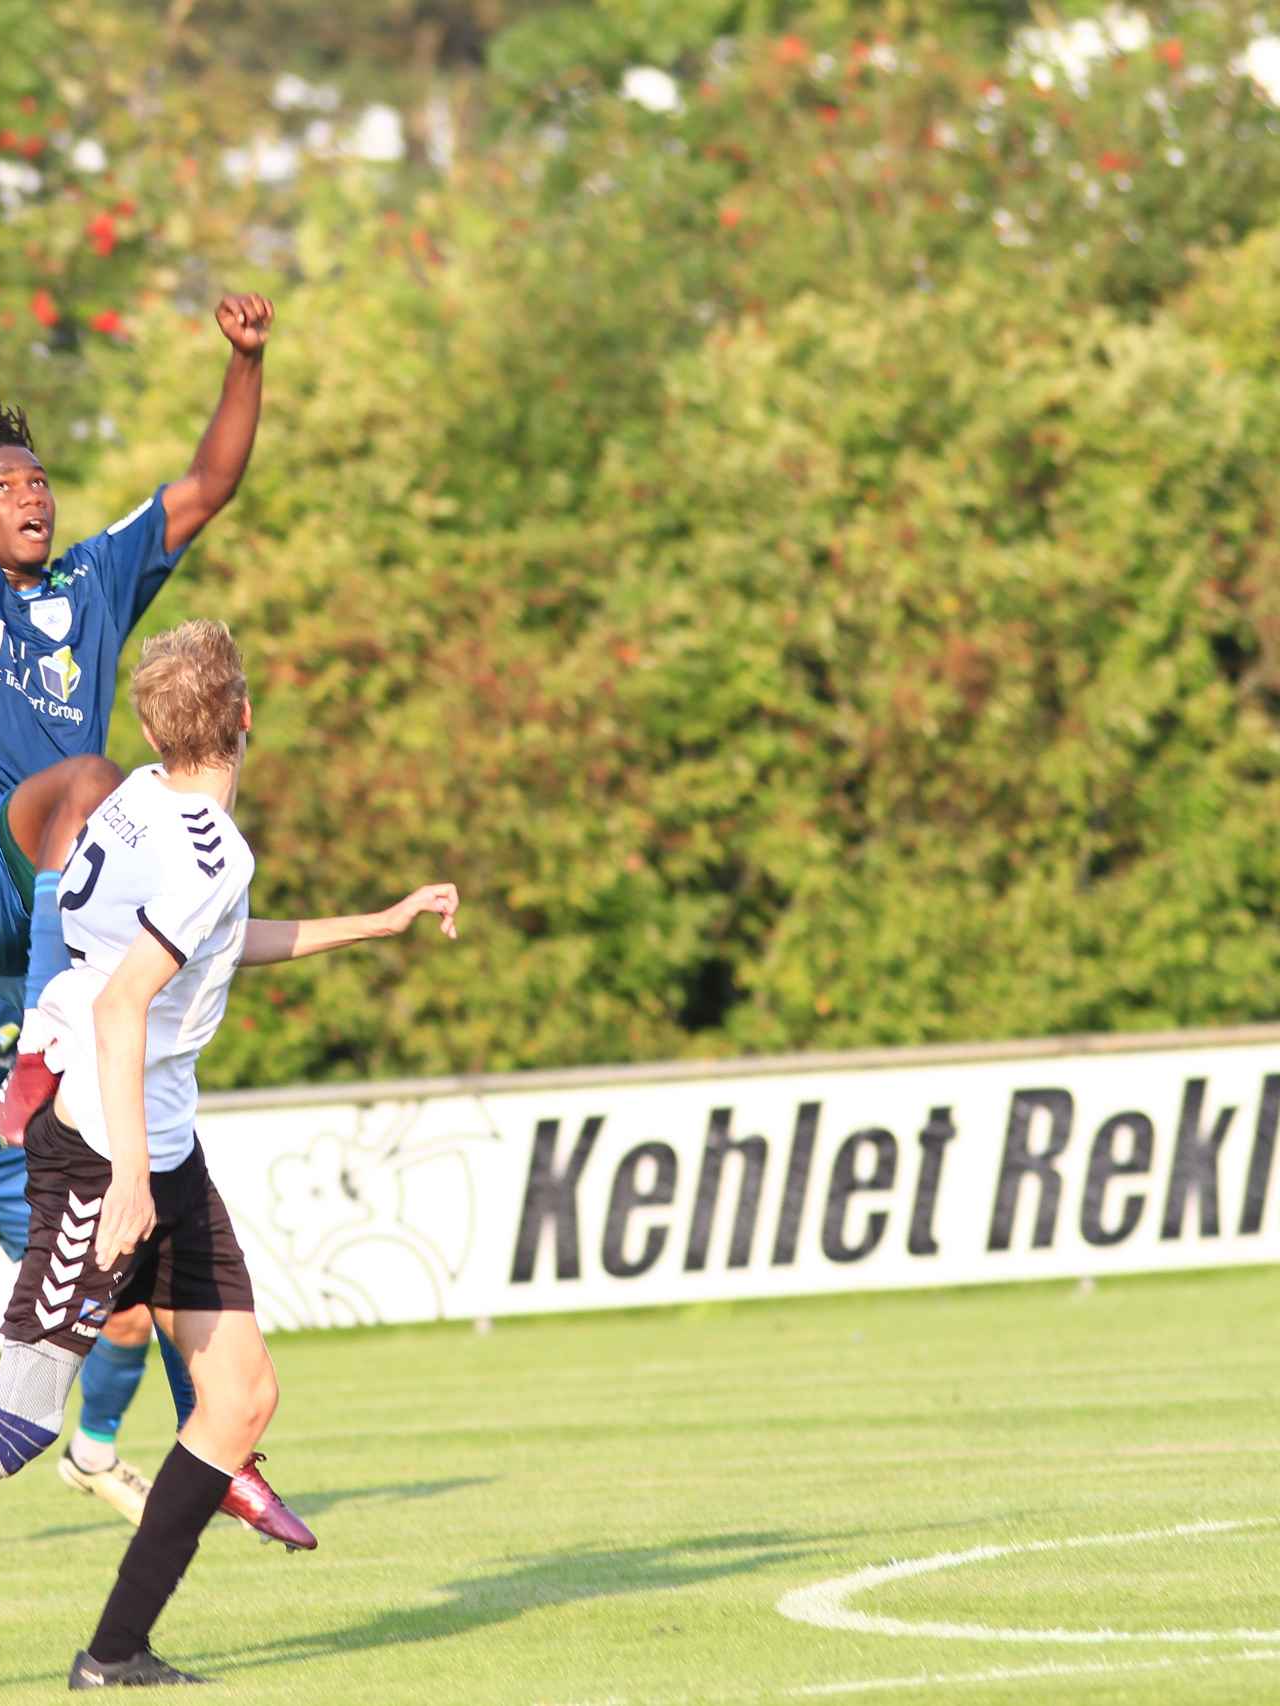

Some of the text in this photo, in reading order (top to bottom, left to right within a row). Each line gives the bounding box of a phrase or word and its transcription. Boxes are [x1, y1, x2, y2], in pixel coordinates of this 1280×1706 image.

[48, 701, 84, 726] Group
[510, 1071, 1280, 1284] Kehlet Rekl
